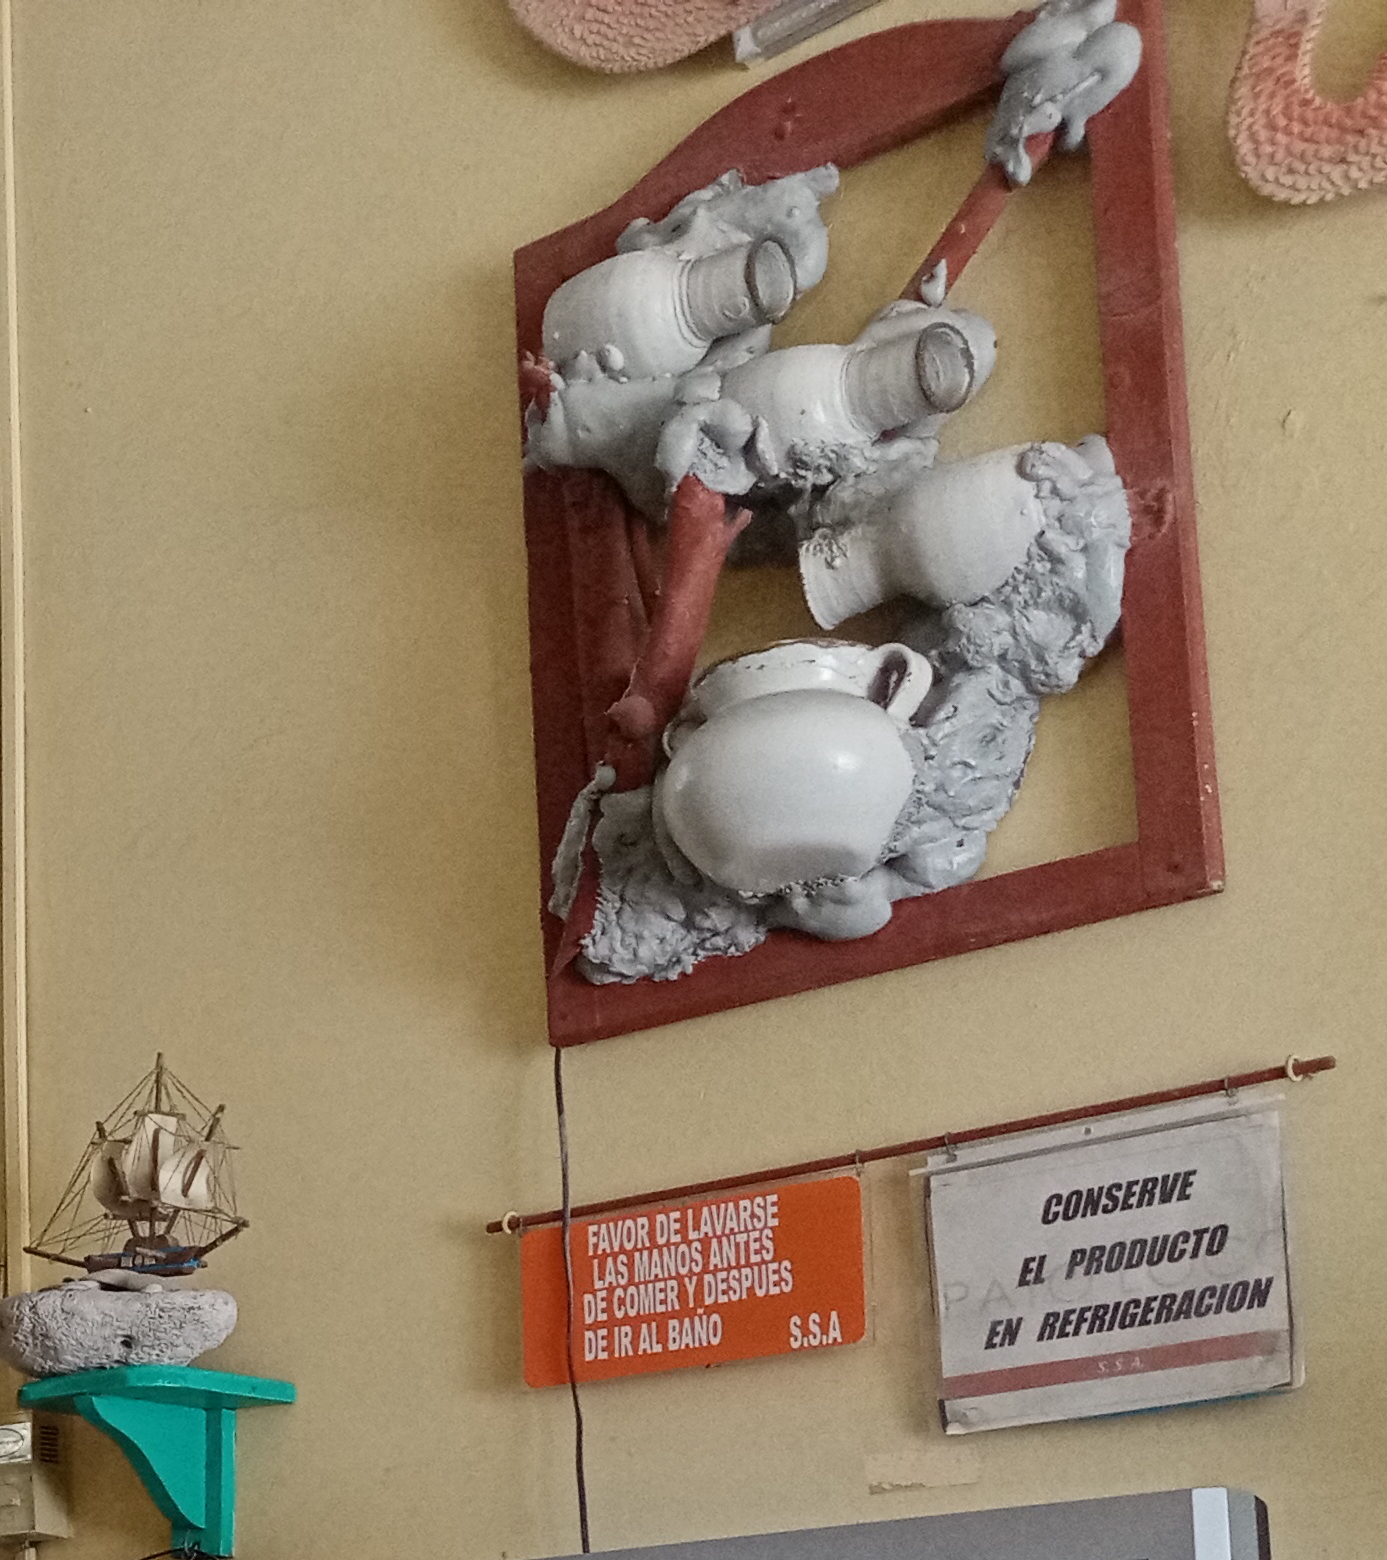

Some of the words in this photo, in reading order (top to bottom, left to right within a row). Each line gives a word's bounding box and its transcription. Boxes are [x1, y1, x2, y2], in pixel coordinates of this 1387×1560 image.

[588, 1216, 650, 1256] FAVOR
[656, 1212, 681, 1245] DE
[687, 1194, 779, 1240] LAVARSE
[1041, 1169, 1197, 1225] CONSERVE
[593, 1254, 627, 1289] LAS
[634, 1241, 703, 1282] MANOS
[709, 1229, 774, 1270] ANTES
[1016, 1254, 1048, 1289] EL
[1065, 1224, 1229, 1280] PRODUCTO
[584, 1290, 608, 1324] DE
[613, 1278, 678, 1318] COMER
[684, 1276, 698, 1308] Y
[703, 1260, 793, 1305] DESPUES
[984, 1316, 1023, 1350] EN
[1037, 1277, 1274, 1342] REFRIGERACION
[584, 1328, 608, 1361] DE
[614, 1326, 633, 1357] IR
[638, 1322, 662, 1355] AL
[668, 1308, 722, 1351] BAÑO
[789, 1311, 842, 1349] S.S.A
